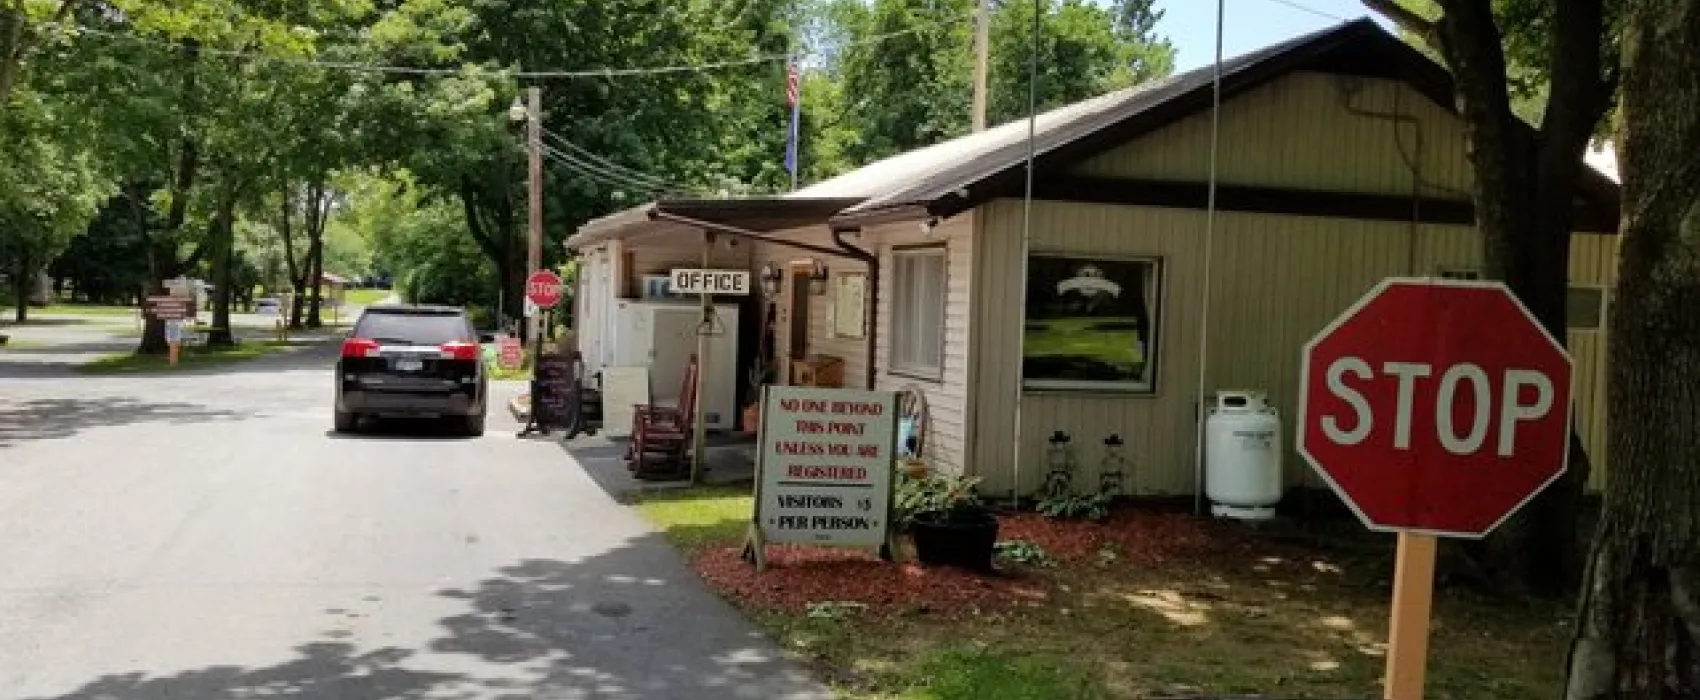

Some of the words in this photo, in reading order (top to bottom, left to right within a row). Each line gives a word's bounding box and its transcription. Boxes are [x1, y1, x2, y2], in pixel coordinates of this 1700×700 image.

[528, 281, 563, 296] STOP
[677, 271, 742, 291] OFFICE
[780, 399, 799, 413] NO
[801, 400, 827, 413] ONE
[831, 402, 883, 415] BEYOND
[1320, 356, 1555, 457] STOP
[796, 420, 824, 434] THIS
[828, 422, 866, 436] POINT
[775, 441, 824, 455] UNLESS
[828, 443, 850, 456] YOU
[857, 444, 879, 458] ARE
[788, 465, 867, 479] REGISTERED
[778, 494, 842, 508] VISITORS
[778, 515, 808, 529] PER
[812, 516, 869, 530] PERSON
